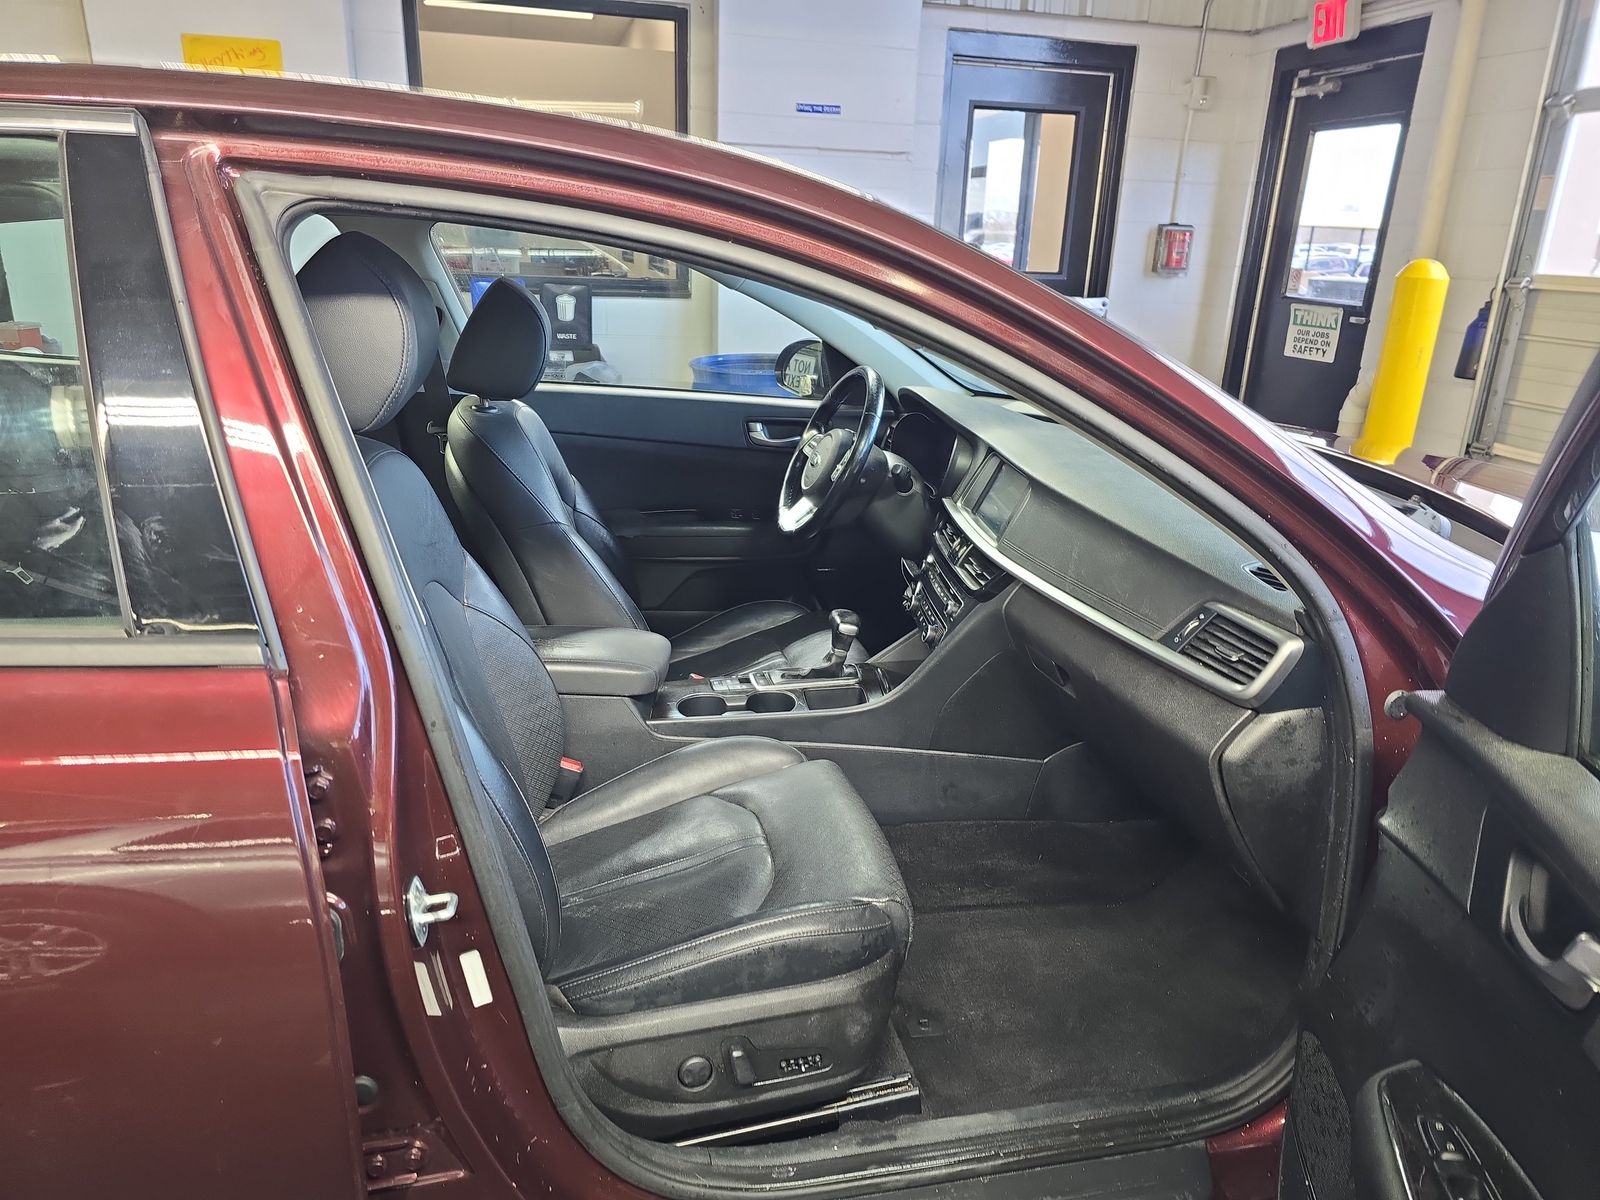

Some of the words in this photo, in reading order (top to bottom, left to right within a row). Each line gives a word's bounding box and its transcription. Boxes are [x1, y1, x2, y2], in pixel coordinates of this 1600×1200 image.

[1314, 0, 1347, 44] EXIT
[1295, 309, 1338, 329] THINK
[1296, 328, 1311, 336] OUR
[1311, 331, 1330, 339] JOBS
[1293, 336, 1319, 346] DEPEND
[1292, 344, 1328, 358] SAFETY
